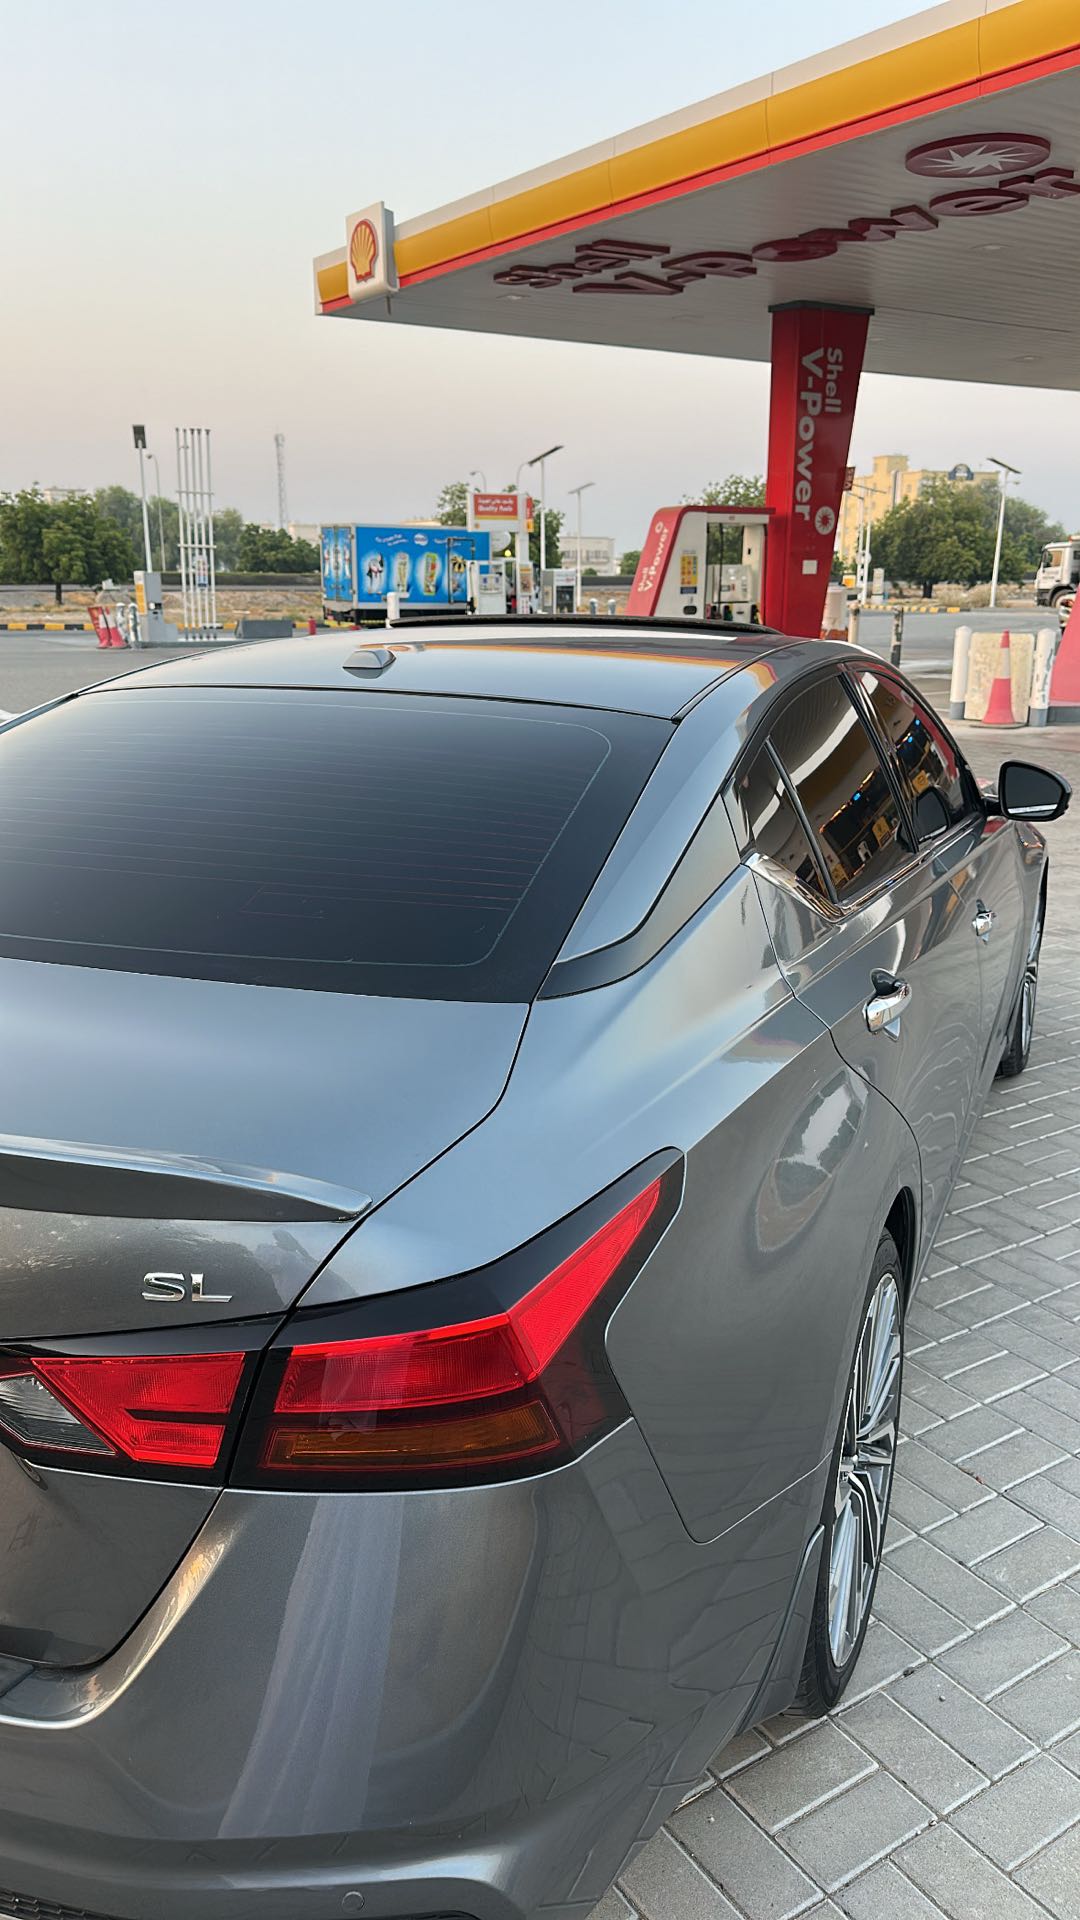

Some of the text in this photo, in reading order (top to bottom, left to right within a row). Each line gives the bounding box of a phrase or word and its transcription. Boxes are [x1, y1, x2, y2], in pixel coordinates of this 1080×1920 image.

[493, 239, 671, 289] Shell
[825, 347, 843, 413] Shell
[795, 346, 825, 521] V-Power
[643, 527, 669, 592] V-Power
[142, 1272, 233, 1303] SL
